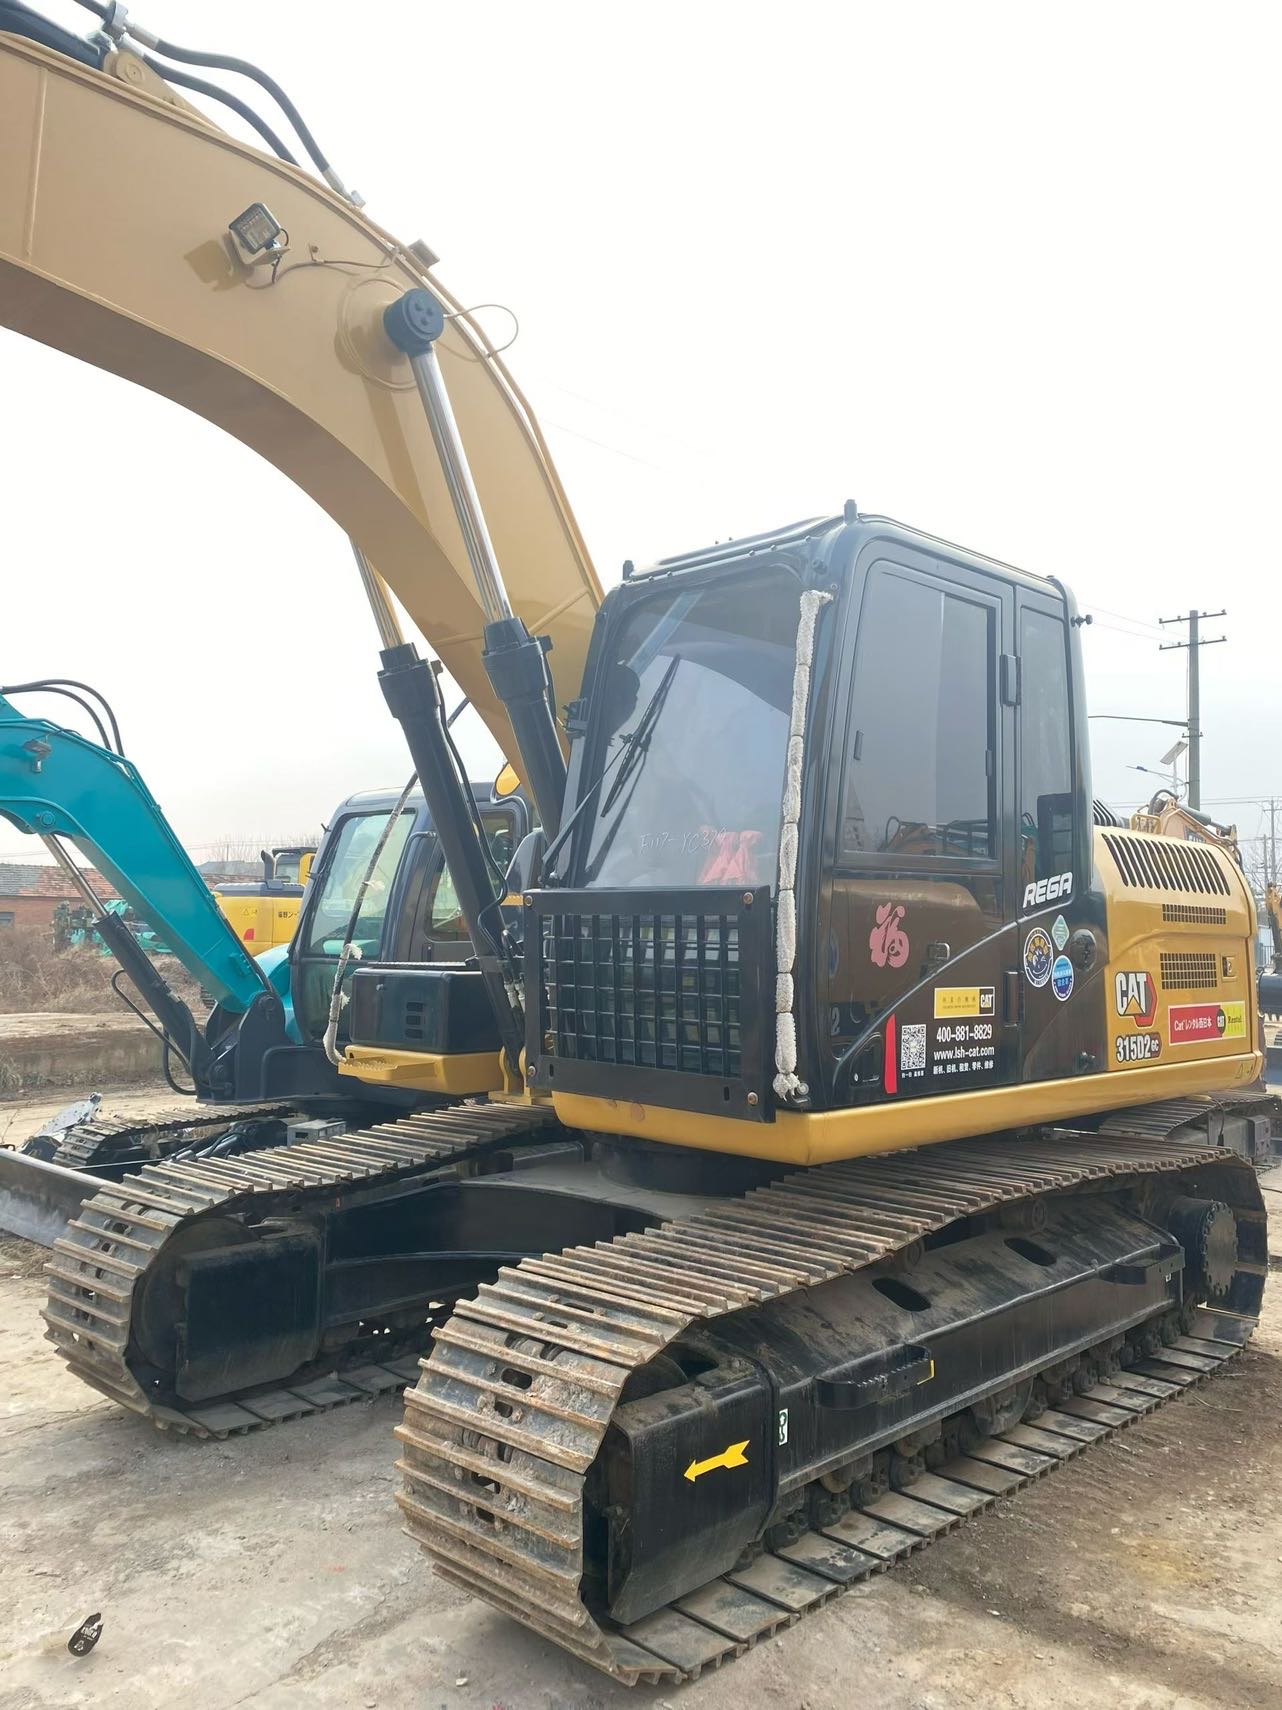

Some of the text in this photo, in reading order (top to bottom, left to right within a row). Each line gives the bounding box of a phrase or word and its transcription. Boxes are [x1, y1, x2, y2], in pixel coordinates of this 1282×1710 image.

[1023, 872, 1072, 908] REGA
[980, 993, 993, 1008] CAT
[1116, 973, 1146, 1015] CAT
[936, 1024, 992, 1042] 400-881-8829
[934, 1046, 995, 1060] www.lsh-cat.com
